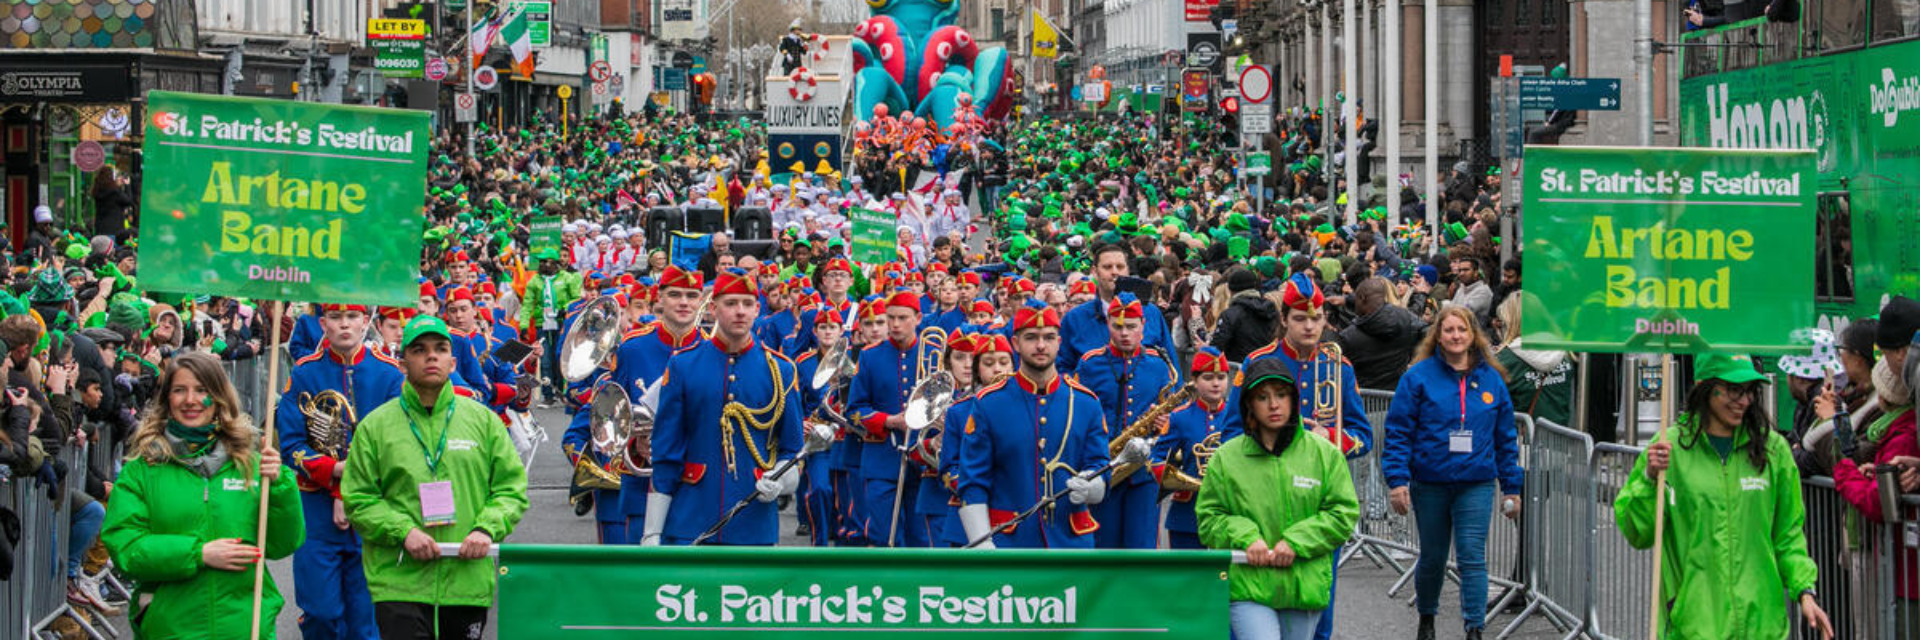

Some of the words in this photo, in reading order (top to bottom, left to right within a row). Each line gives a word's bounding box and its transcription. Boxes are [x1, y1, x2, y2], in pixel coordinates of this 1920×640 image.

[375, 22, 399, 31] LET
[401, 22, 417, 31] BY
[19, 77, 82, 89] OLYMPIA
[1870, 67, 1920, 128] DoDubli
[162, 112, 194, 137] St.
[201, 114, 312, 145] Patrick's
[318, 123, 414, 153] Festival
[768, 106, 809, 127] LUXURY
[811, 106, 840, 127] LINES
[1769, 96, 1808, 150] on
[201, 161, 367, 213] Artane
[1540, 168, 1573, 193] St.
[1580, 169, 1694, 195] Patrick's
[1701, 171, 1800, 197] Festival
[220, 210, 343, 261] Band
[1584, 215, 1754, 261] Artane
[249, 264, 311, 284] Dublin
[1605, 264, 1730, 310] Band
[1635, 318, 1700, 335] Dublin
[655, 584, 708, 622] St.
[721, 584, 907, 624] Patrick's
[919, 584, 1077, 624] Festival
